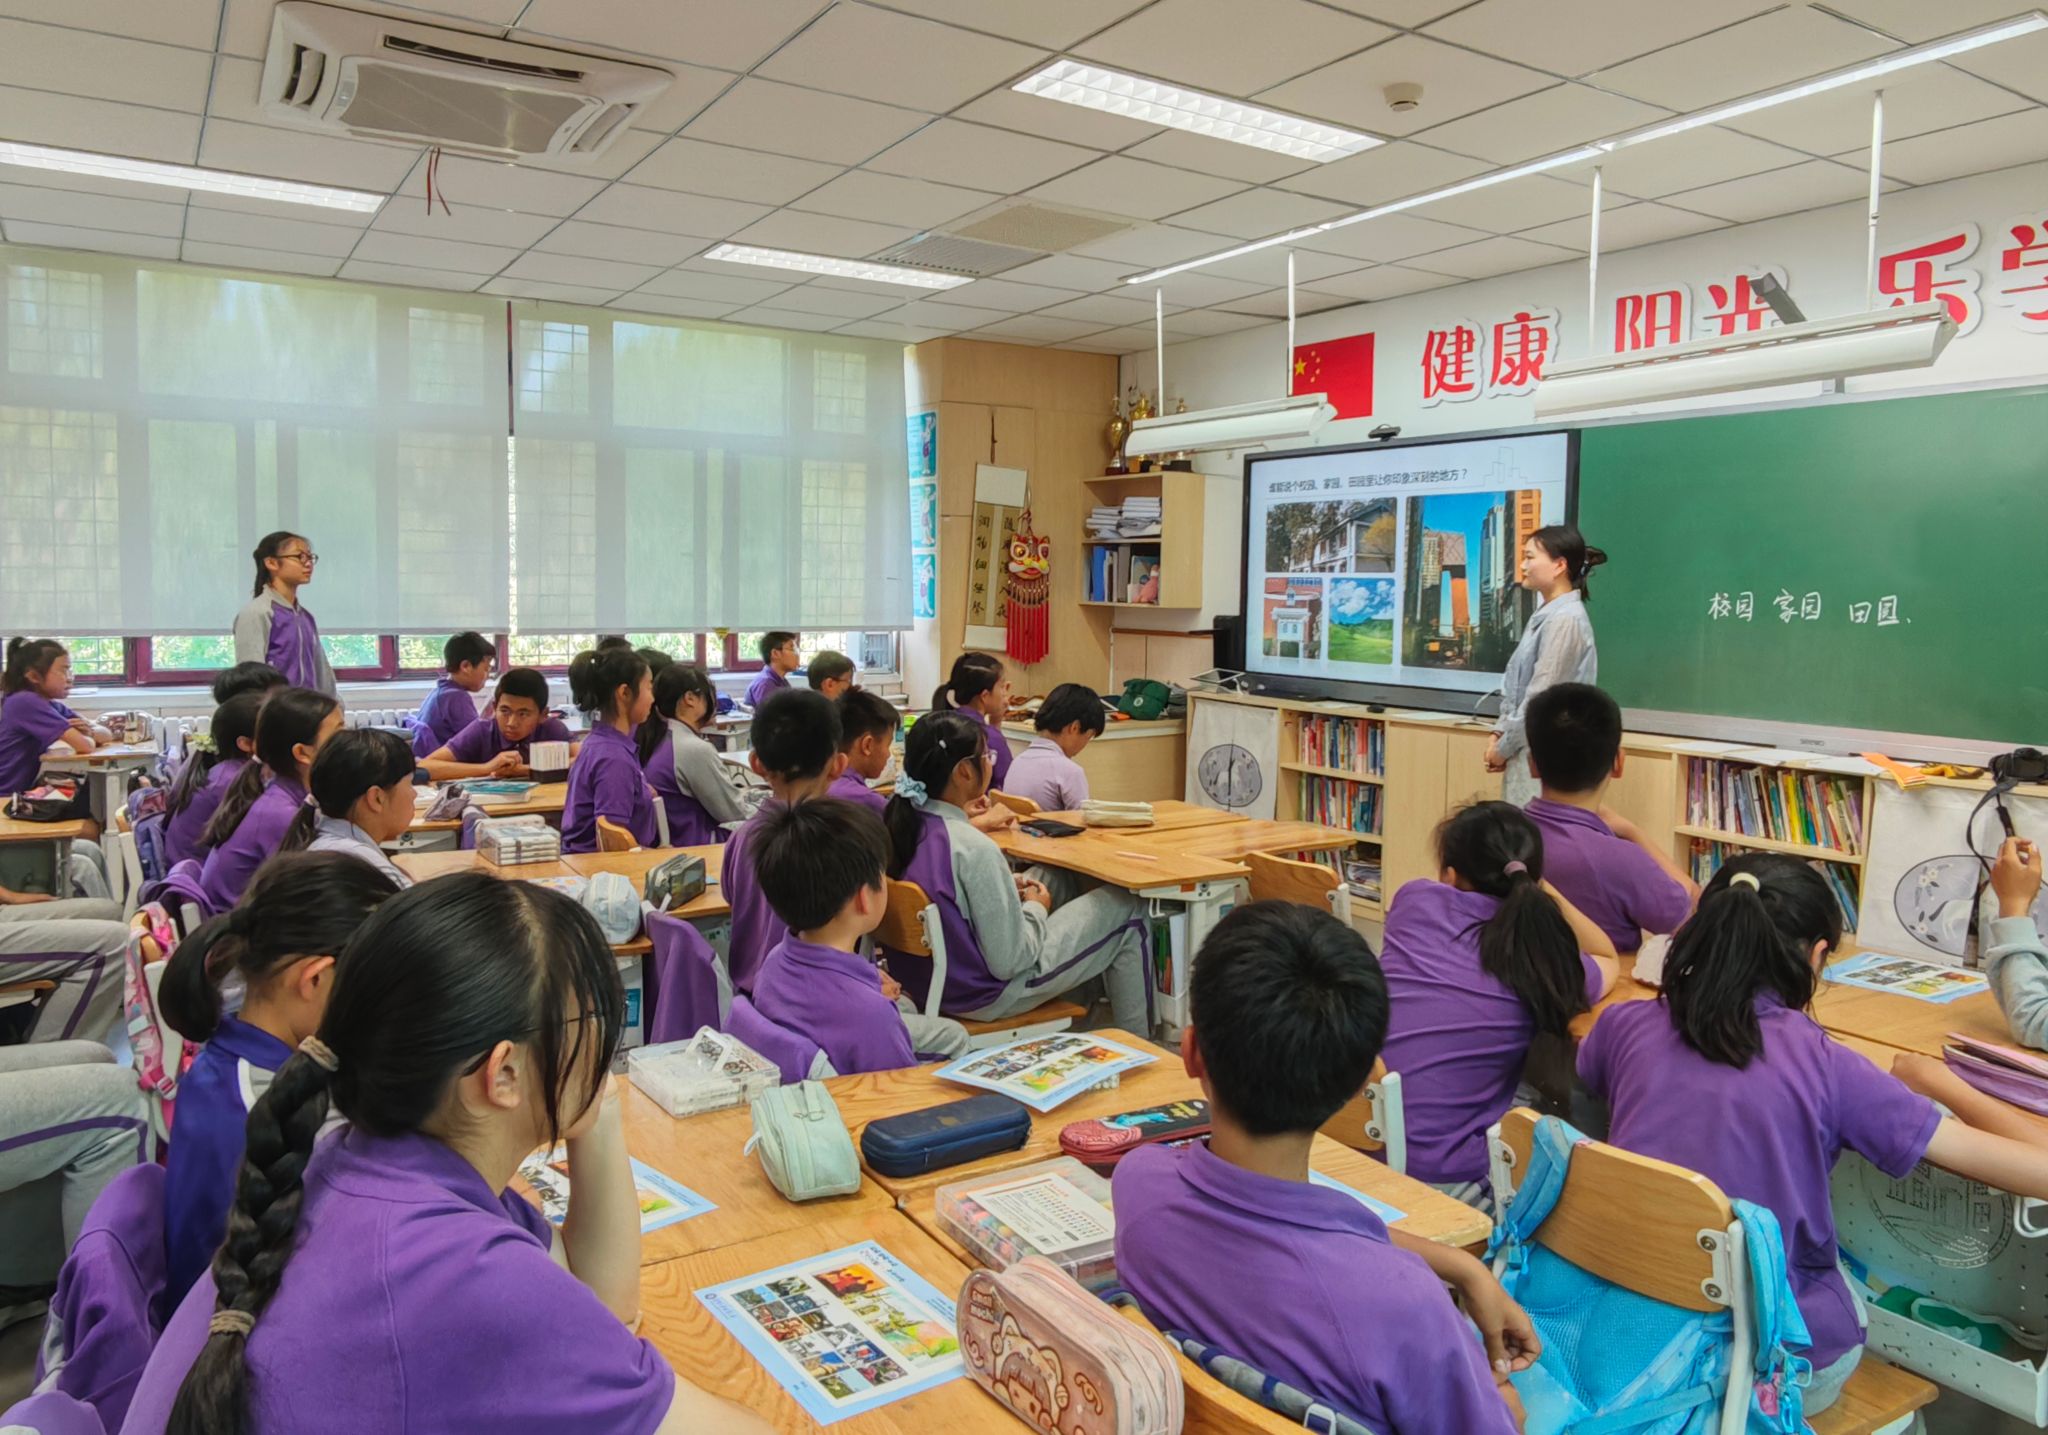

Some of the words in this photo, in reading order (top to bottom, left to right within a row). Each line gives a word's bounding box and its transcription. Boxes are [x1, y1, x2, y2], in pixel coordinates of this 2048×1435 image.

[1421, 312, 1549, 398] 健康
[1615, 275, 1772, 352] 阳光
[1708, 592, 1753, 621] 校园
[1773, 588, 1821, 623] 家园
